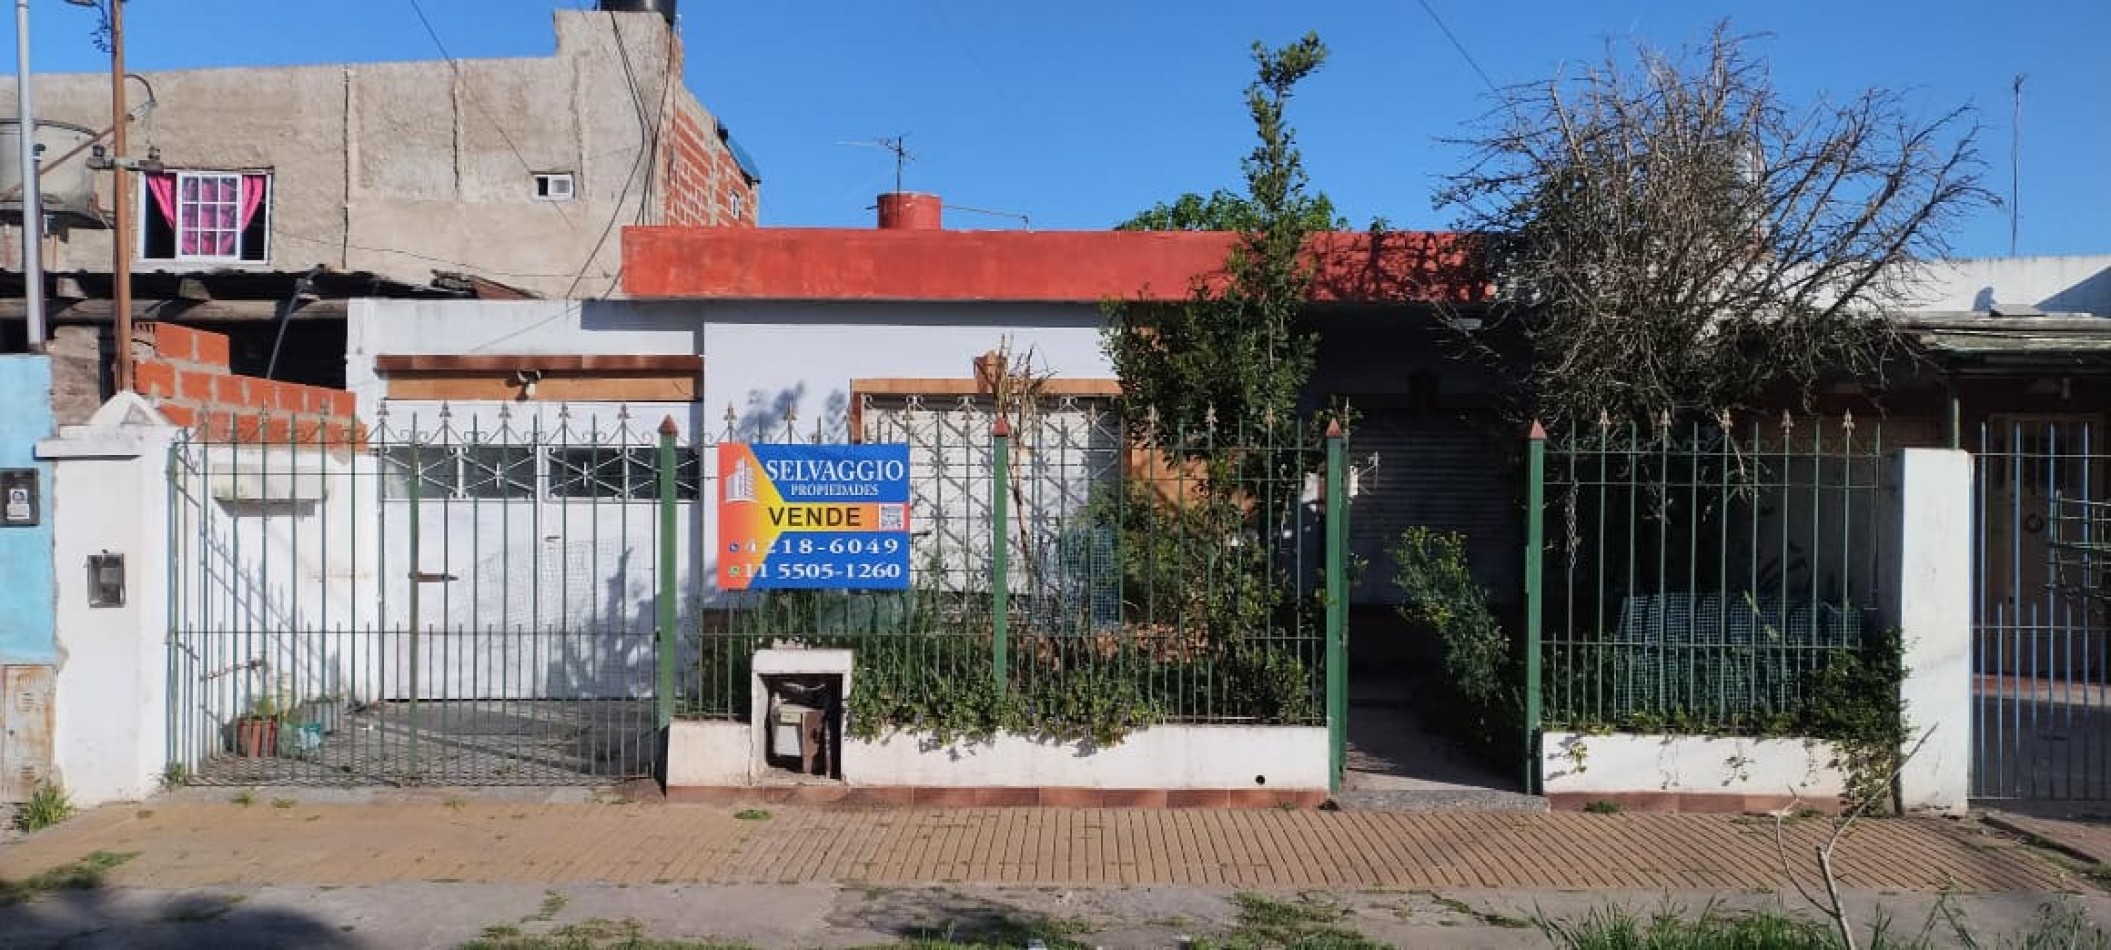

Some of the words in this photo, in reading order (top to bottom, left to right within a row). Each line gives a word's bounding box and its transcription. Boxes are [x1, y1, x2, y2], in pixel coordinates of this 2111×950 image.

[766, 459, 904, 482] SELVAGGIO
[791, 484, 879, 496] PROPIEDADES
[768, 507, 861, 527] VENDE
[744, 563, 768, 579] 11
[778, 563, 901, 579] 5505-1260
